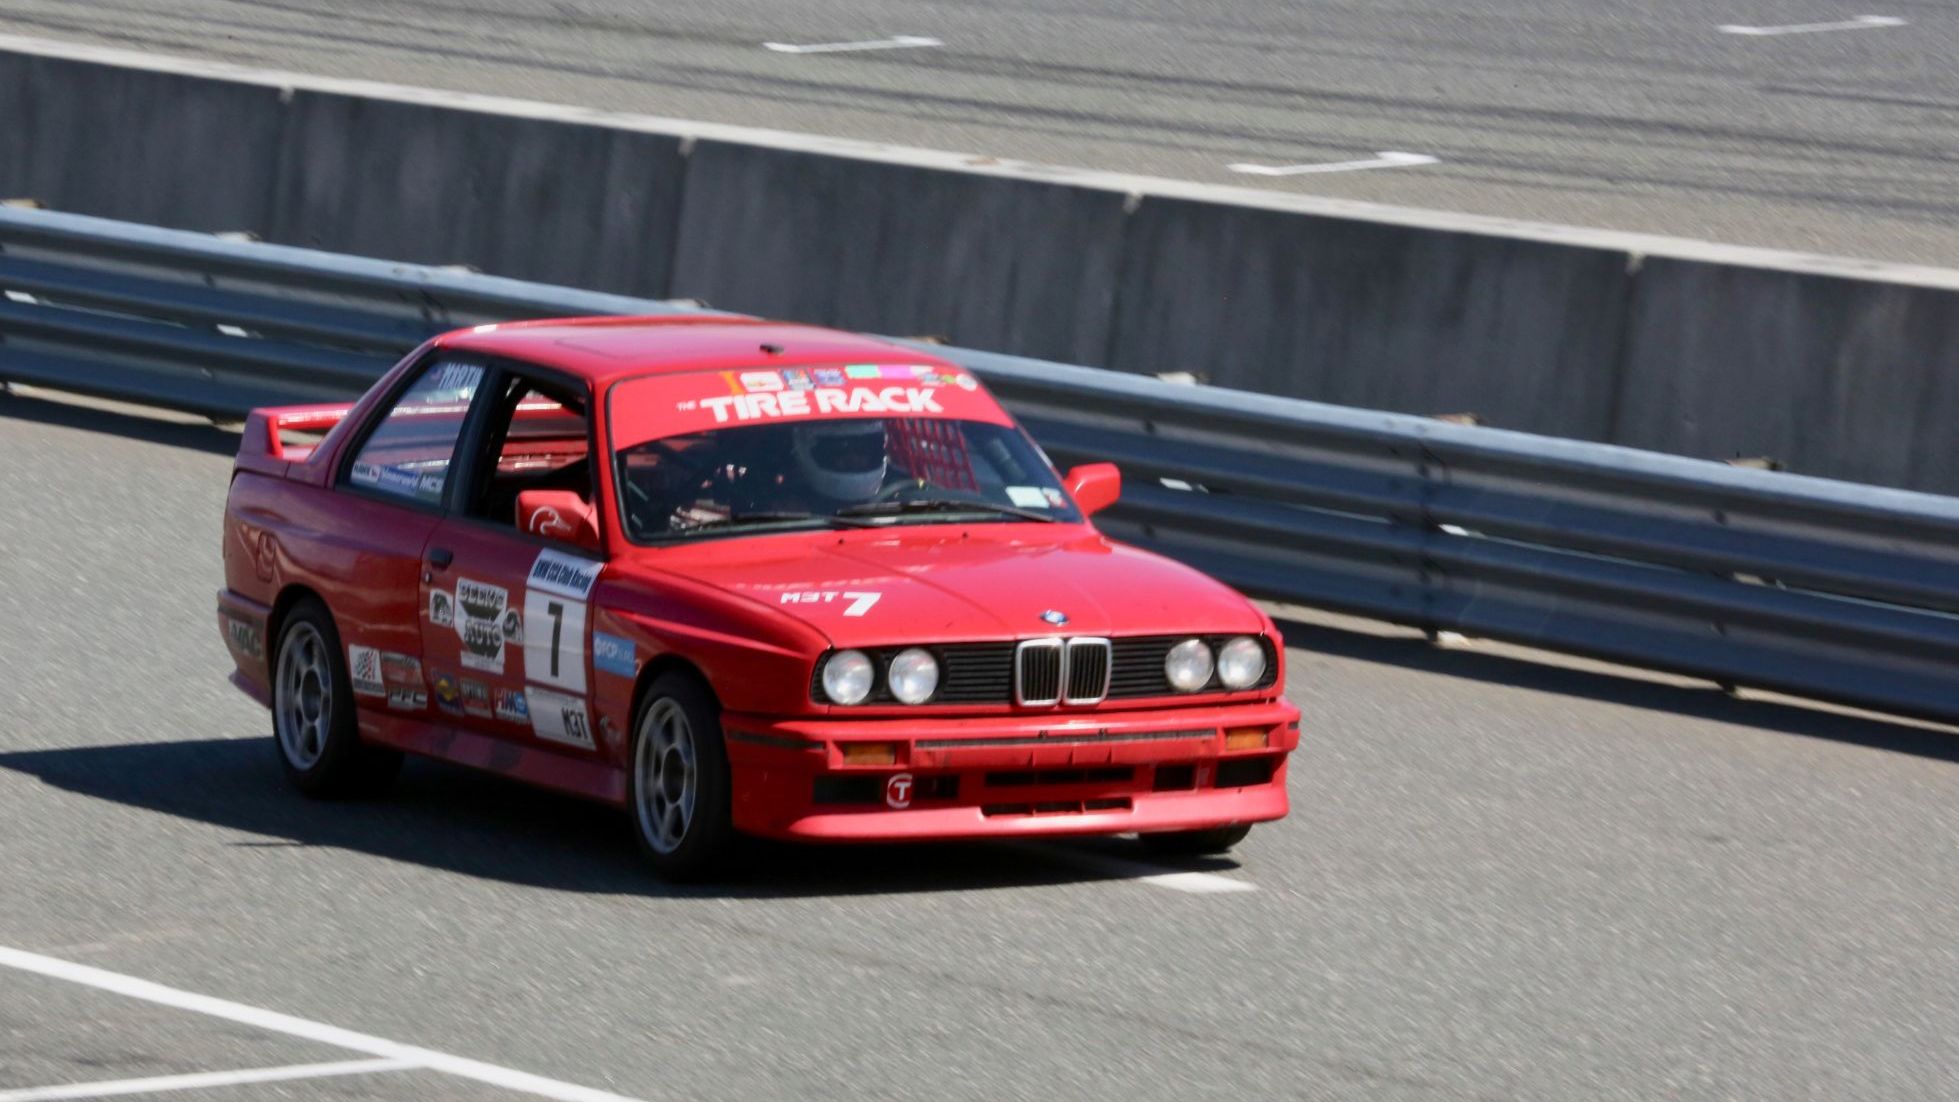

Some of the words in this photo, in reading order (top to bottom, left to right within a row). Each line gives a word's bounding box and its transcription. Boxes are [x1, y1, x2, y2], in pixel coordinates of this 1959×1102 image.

[677, 400, 696, 412] THE
[700, 391, 811, 423] TIRE
[814, 387, 944, 413] RACK
[569, 570, 592, 594] Racing
[843, 592, 882, 616] 7
[464, 618, 503, 647] AUTO
